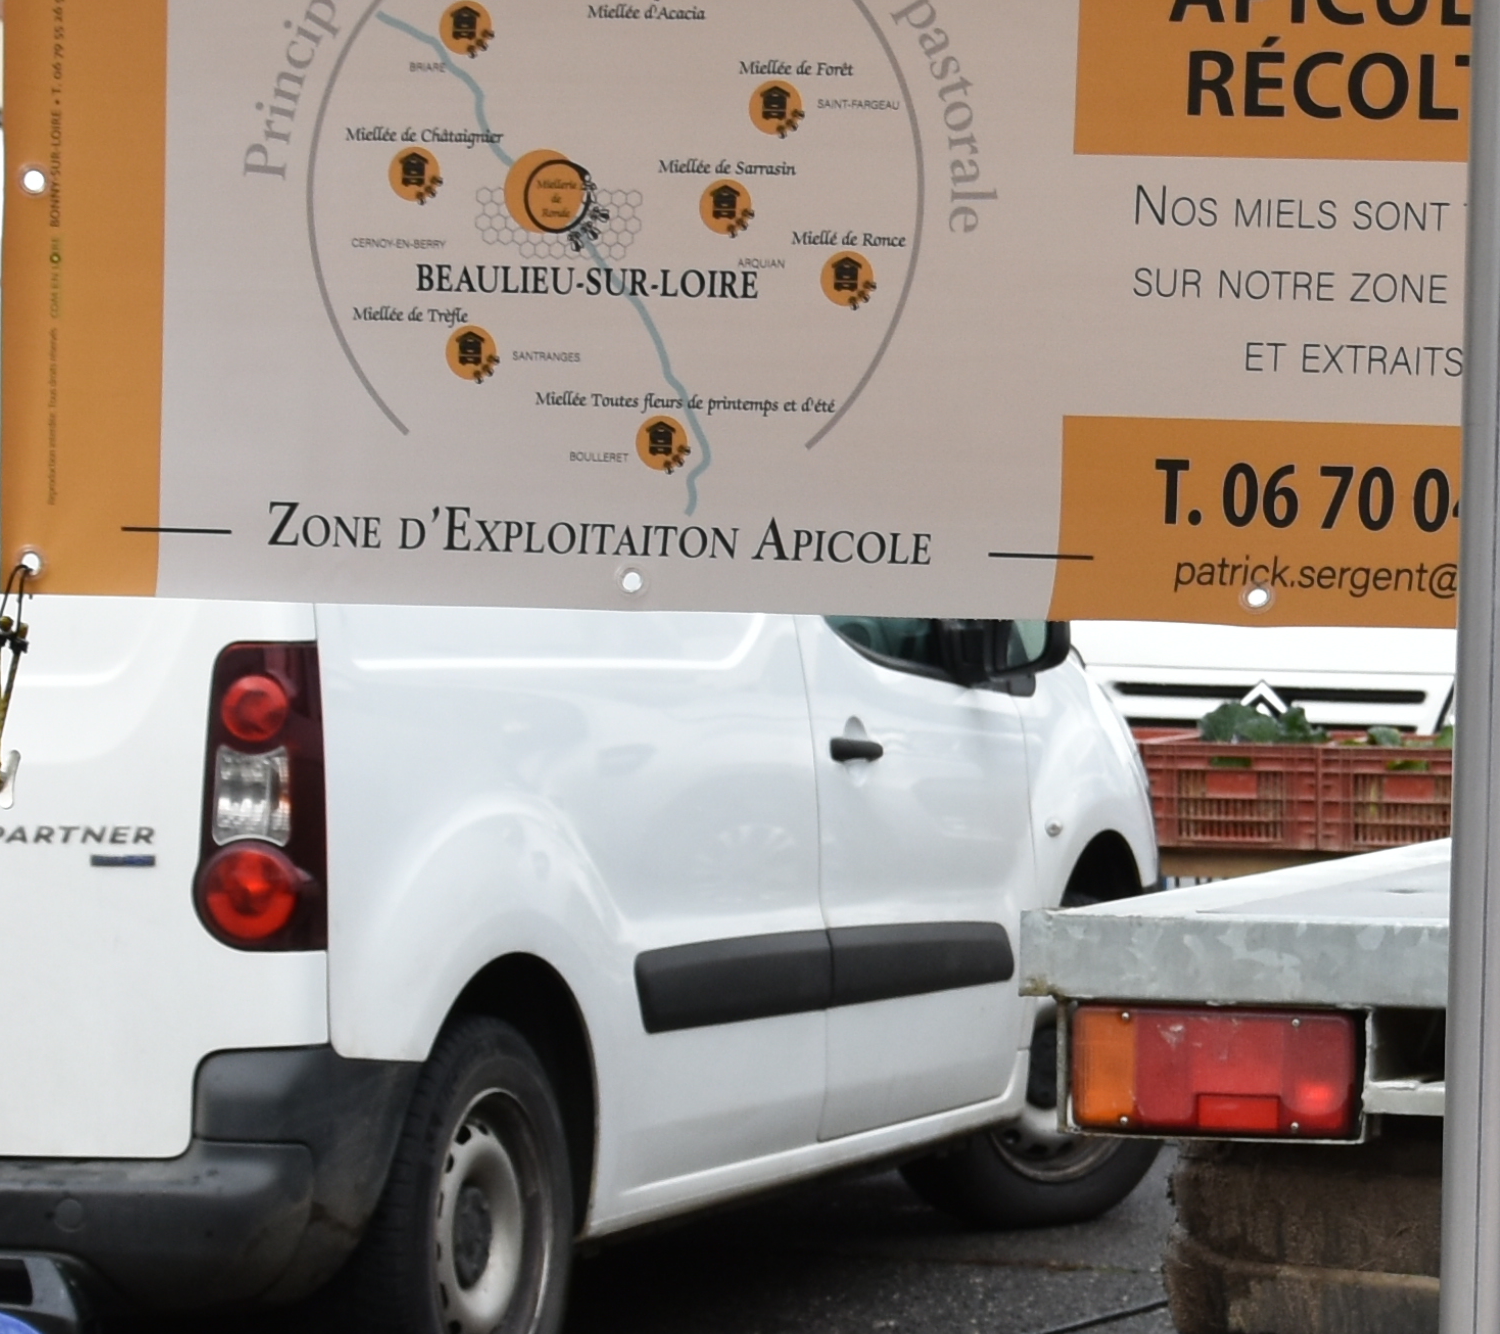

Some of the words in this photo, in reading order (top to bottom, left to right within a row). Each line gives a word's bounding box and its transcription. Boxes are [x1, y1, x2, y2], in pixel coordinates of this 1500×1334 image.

[588, 4, 640, 19] Miellée
[645, 5, 706, 20] d'Acacia
[739, 60, 791, 75] Miellée
[796, 60, 812, 76] de
[817, 62, 853, 77] Forêt
[817, 99, 899, 110] SAINT-FARGEAU
[346, 127, 396, 142] Miellée
[401, 127, 417, 142] de
[421, 129, 503, 148] Châtaignier
[658, 158, 710, 174] Miellée
[715, 160, 731, 174] de
[735, 161, 796, 176] Sarrasin
[352, 238, 446, 249] CERNOY-EN-BERRY
[791, 231, 837, 246] Miellé
[842, 231, 857, 246] de
[863, 233, 906, 247] Ronce
[738, 259, 785, 269] ARQUIAN
[416, 264, 759, 299] BEAULIEU-SUR-LOIRE
[353, 306, 403, 321] Miellée
[408, 307, 423, 321] de
[428, 308, 468, 328] Trèfle
[513, 351, 580, 362] SANTRANGES
[536, 391, 586, 406] Miellée
[591, 394, 638, 407] Toutes
[641, 393, 683, 414] fleurs
[687, 394, 702, 409] de
[708, 398, 778, 416] printemps
[783, 400, 797, 412] et
[802, 398, 835, 413] d'été
[570, 452, 628, 462] BOULLERET
[1155, 458, 1201, 526] T.
[1222, 462, 1299, 528] 06
[1319, 465, 1395, 530] 70
[1413, 468, 1461, 532] 0
